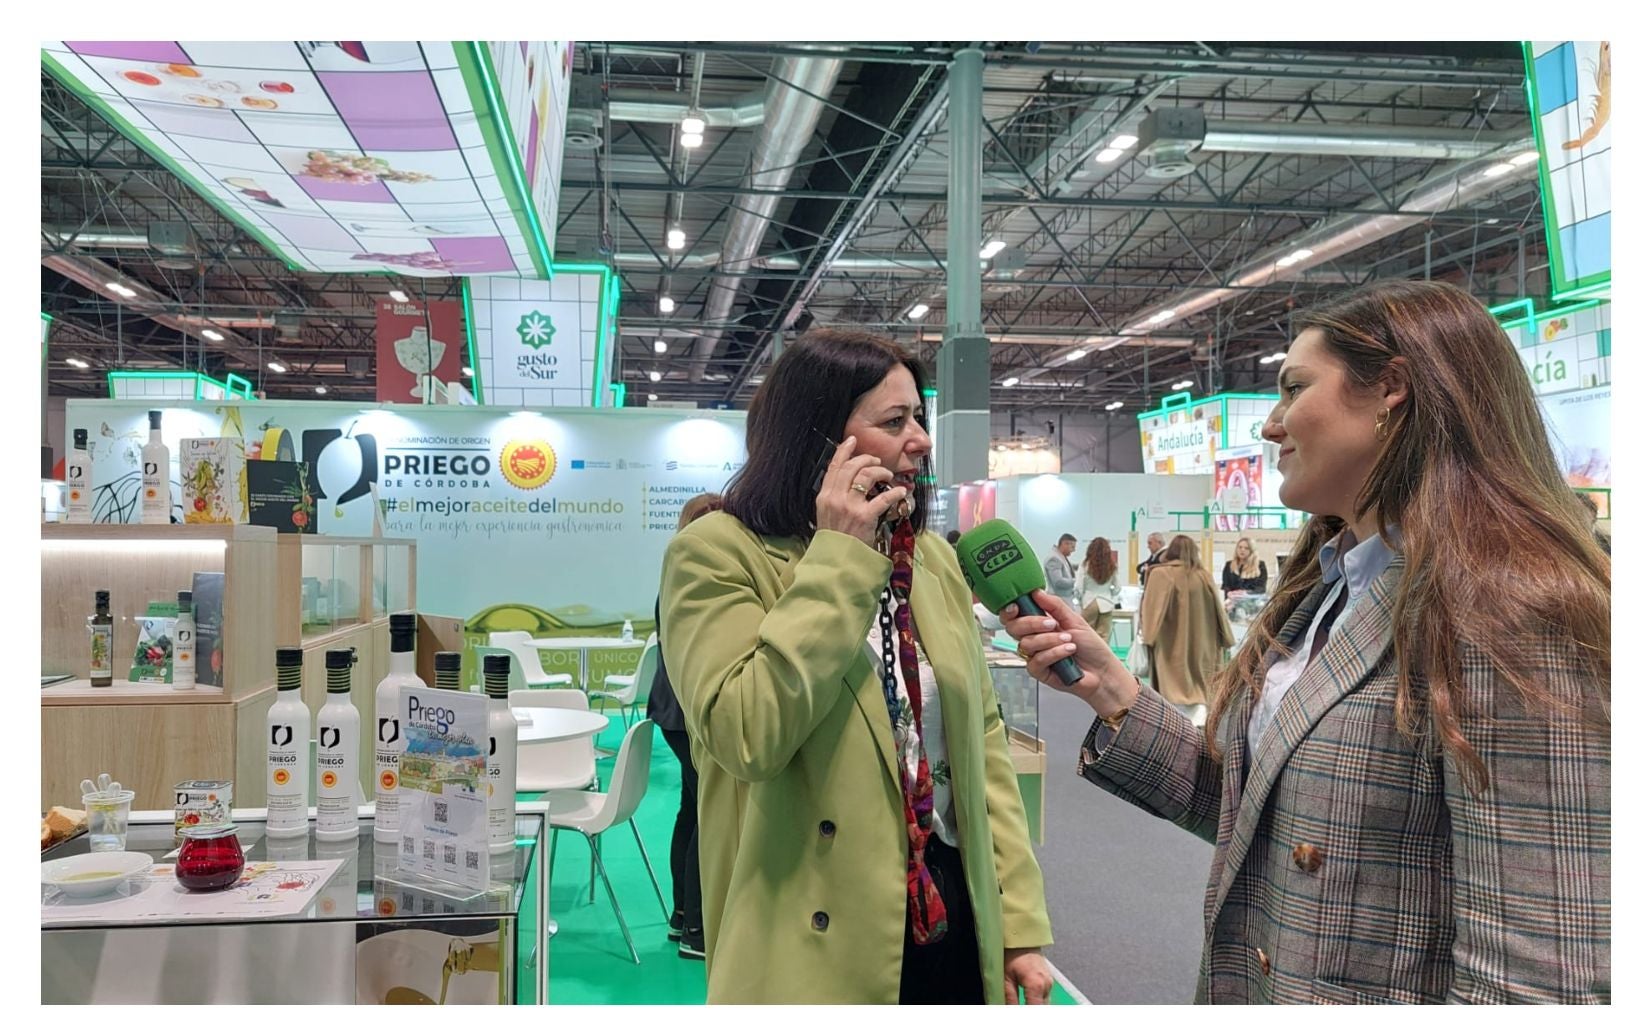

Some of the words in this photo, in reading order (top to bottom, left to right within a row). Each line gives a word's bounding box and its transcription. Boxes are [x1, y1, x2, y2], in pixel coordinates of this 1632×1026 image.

[517, 352, 557, 371] gusto
[1533, 350, 1566, 384] cía
[530, 365, 557, 380] Sur
[1157, 426, 1203, 451] Andalucía
[385, 455, 491, 476] PRIEGO
[385, 480, 403, 488] DE
[414, 477, 491, 488] CÓRDOBA
[649, 498, 685, 506] CARCAB
[649, 523, 678, 531] PRIEG
[980, 541, 1008, 559] ONDA
[987, 551, 1014, 569] CERO
[408, 695, 455, 735] Priego
[376, 754, 399, 764] PRIEG
